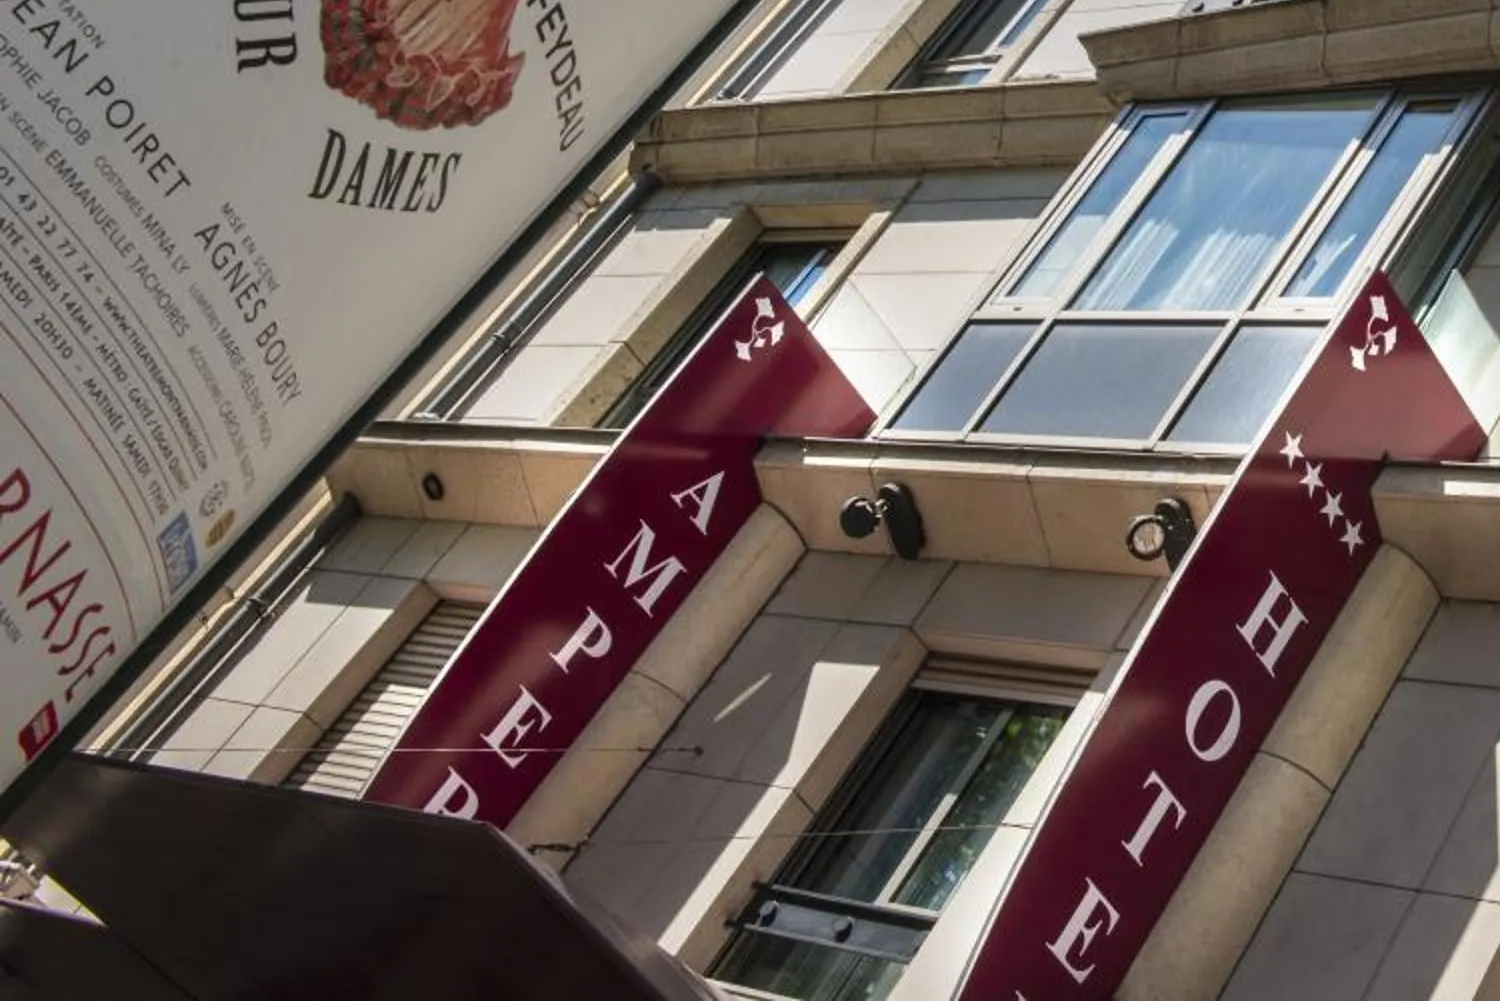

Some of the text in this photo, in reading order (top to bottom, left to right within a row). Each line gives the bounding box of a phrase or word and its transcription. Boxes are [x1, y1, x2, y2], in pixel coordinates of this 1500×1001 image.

[37, 89, 91, 146] JACOB
[94, 155, 145, 218] COSTUMES
[141, 213, 174, 257] MINA
[172, 254, 190, 275] LY
[85, 75, 191, 198] POIRET
[308, 129, 462, 213] DAMES
[18, 194, 37, 212] 43
[37, 215, 57, 235] 22
[58, 238, 77, 258] 77
[77, 258, 94, 283] 74
[44, 148, 134, 257] EMMANUELLE
[128, 254, 190, 338] TACHOIRES
[28, 253, 60, 292] PARIS
[98, 342, 128, 383] MÉTRO
[34, 313, 74, 359] 20H30
[83, 378, 125, 433] MATINÉE
[194, 222, 302, 404] AGNÈS BOURY
[1014, 569, 1309, 1001] HOTE
